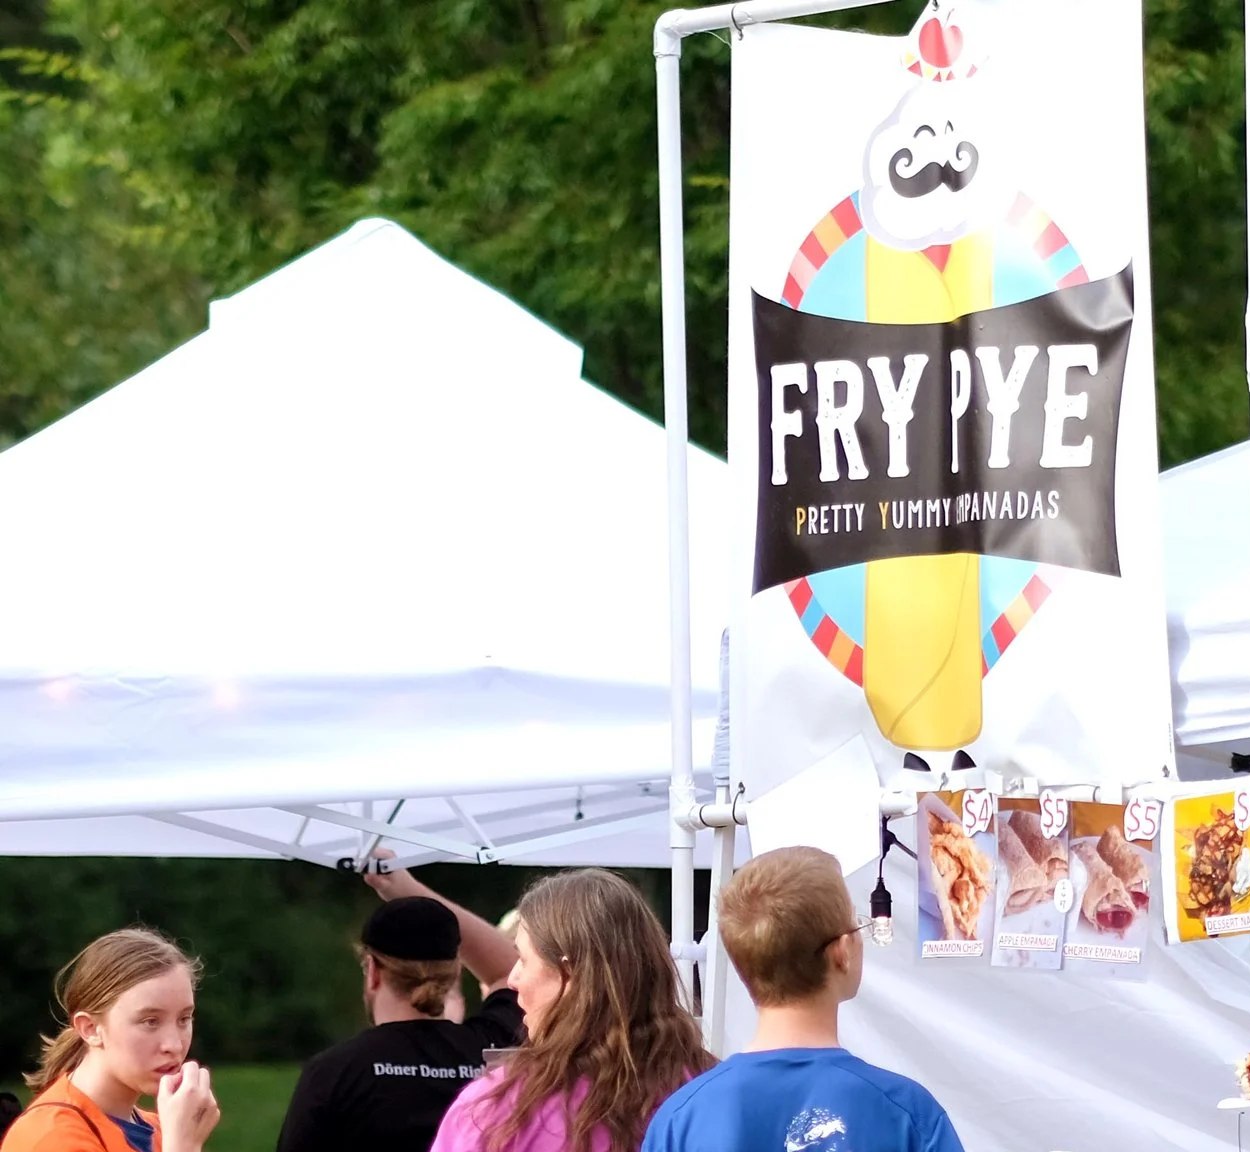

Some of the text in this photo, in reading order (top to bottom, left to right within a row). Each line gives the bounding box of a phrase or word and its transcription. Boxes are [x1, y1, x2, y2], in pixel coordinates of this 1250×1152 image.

[770, 344, 1098, 486] FRY PYE
[795, 503, 865, 536] PRETTY
[879, 498, 951, 530] YUMMY
[965, 794, 989, 834] $4
[1043, 793, 1066, 834] $5
[1127, 798, 1157, 838] $5
[1207, 917, 1239, 931] DESSERT
[963, 943, 983, 953] CHIPS
[1064, 945, 1093, 957] CHERRY
[373, 1062, 418, 1076] Döner
[419, 1065, 457, 1078] Done
